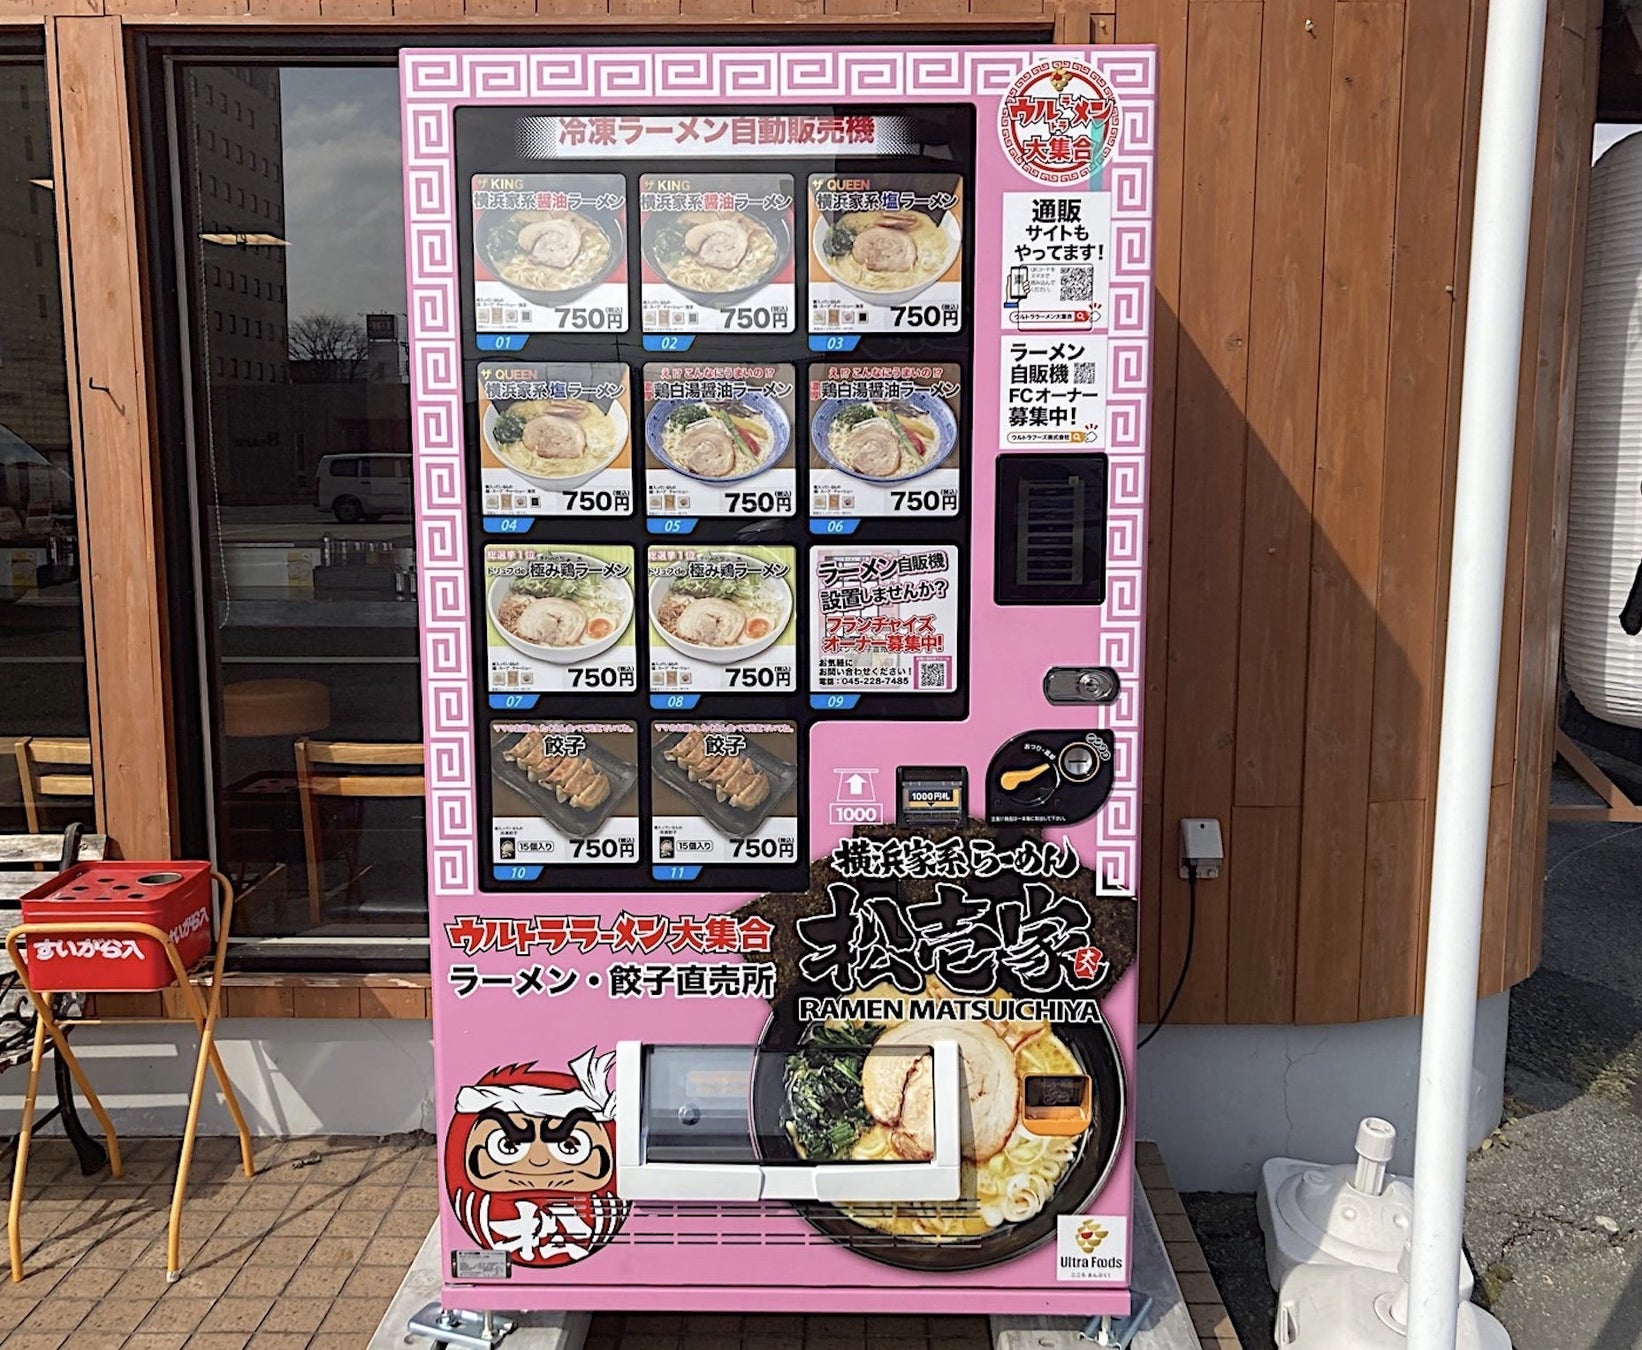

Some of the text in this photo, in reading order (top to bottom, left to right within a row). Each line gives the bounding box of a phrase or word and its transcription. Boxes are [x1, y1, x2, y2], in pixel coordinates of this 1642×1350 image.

[558, 116, 875, 144] 冷凍ラーメン自動販売機
[1023, 136, 1095, 163] 大集合
[491, 179, 524, 190] KING
[658, 180, 691, 191] KING
[812, 179, 870, 190] ザ QUEEN
[474, 192, 625, 210] 横浜家系醤油ラーメン
[641, 193, 792, 211] 横浜家系醤油ラーメン
[1032, 199, 1082, 223] 通販
[1026, 225, 1089, 241] サイトも
[495, 336, 511, 349] 01
[661, 337, 677, 349] 02
[827, 337, 844, 349] 03
[1010, 343, 1085, 362] ラーメン
[480, 369, 538, 380] ザ QUEEN
[1011, 364, 1069, 384] 自販機
[654, 381, 792, 399] 鶏白湯醤油ラーメン
[821, 381, 960, 399] 鶏白湯醤油ラーメン
[1009, 388, 1098, 403] FCオーナー
[500, 519, 517, 531] 04
[664, 520, 681, 533] 05
[827, 520, 844, 532] 06
[530, 562, 631, 578] 極み鶏ラーメン
[689, 562, 790, 578] 極み鶏ラーメン
[818, 552, 948, 586] ラーメン自販機
[825, 616, 935, 634] フランチャイズ
[506, 696, 522, 707] 07
[667, 696, 684, 707] 08
[827, 696, 844, 707] 09
[544, 735, 586, 756] 餃子
[704, 735, 746, 756] 餃子
[836, 808, 877, 822] 1000
[519, 842, 552, 851] 15個入り
[678, 842, 711, 851] 15個入り
[512, 867, 526, 878] 10
[671, 867, 685, 878] 11
[444, 910, 774, 956] ウルトララーメン大集合
[33, 938, 146, 961] すいがら入
[449, 963, 776, 998] ラーメン・餃子直売所
[799, 999, 1101, 1023] RAMEN MATSUICHIYA
[1060, 1256, 1122, 1268] Ultra Foods
